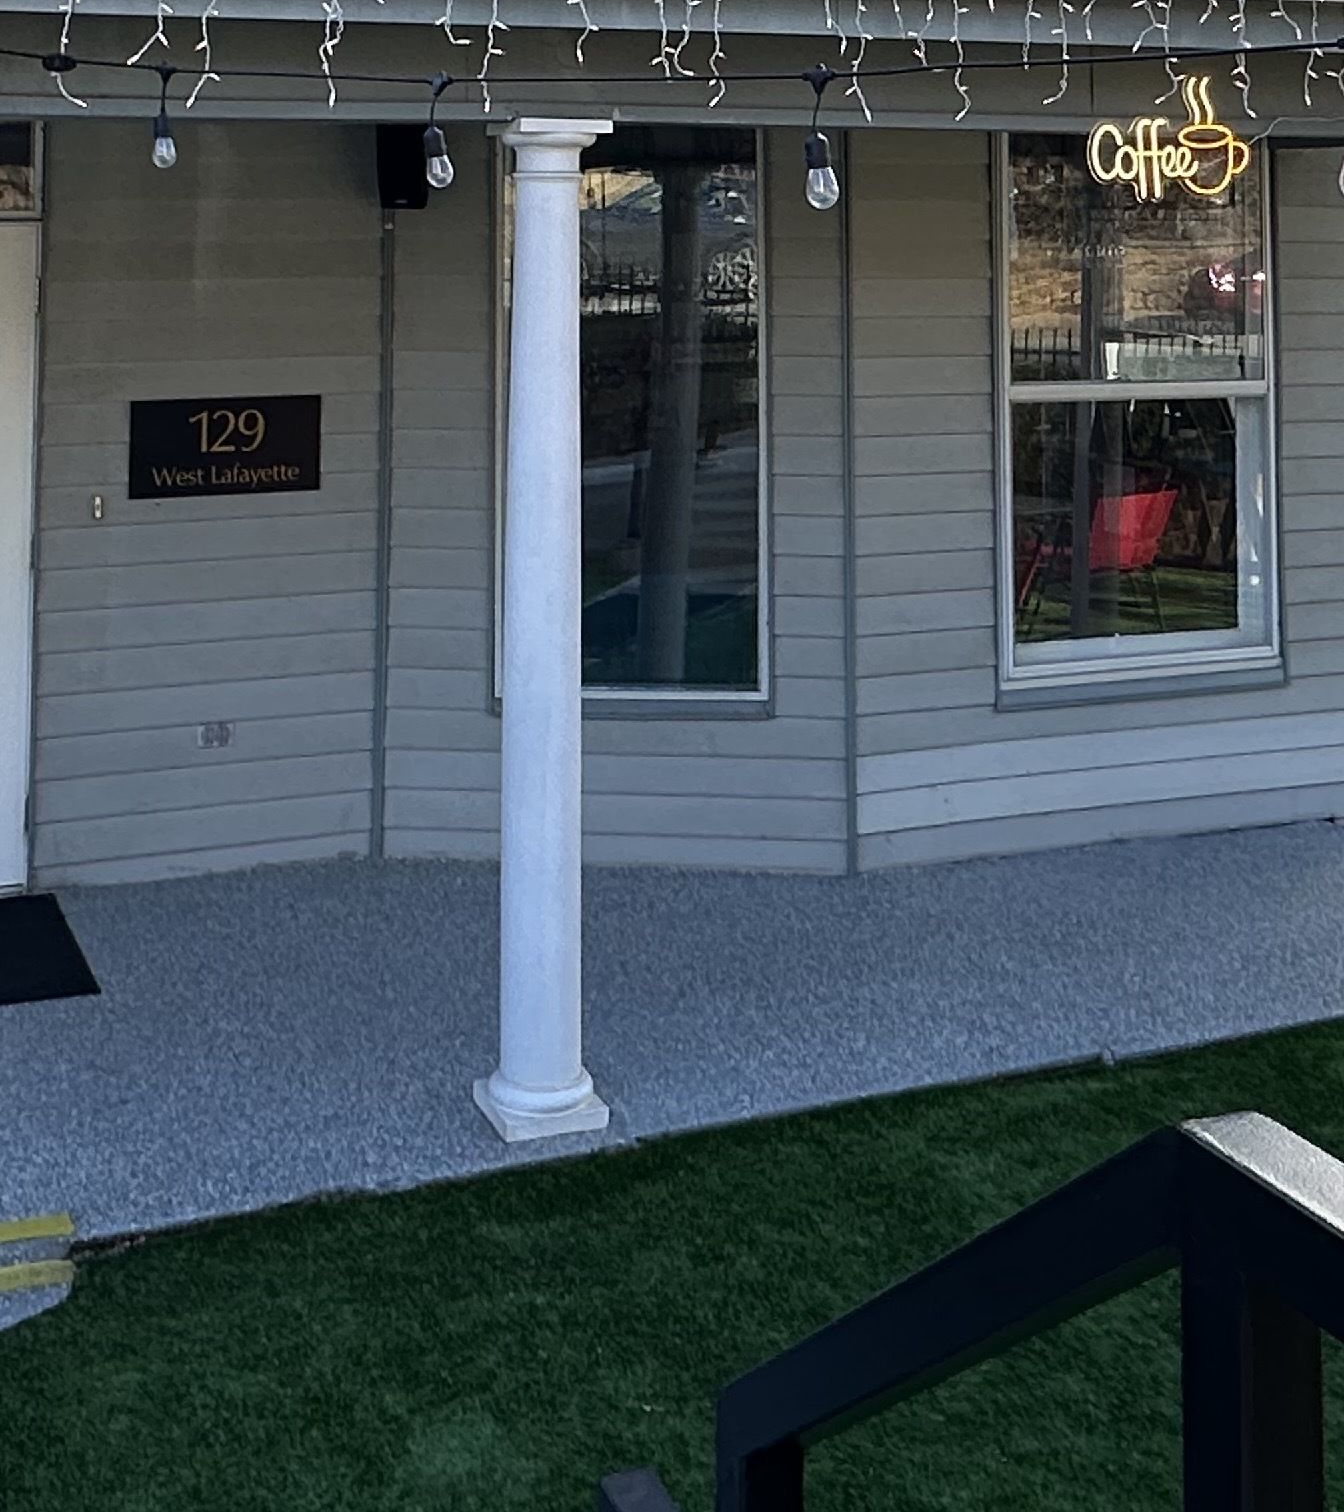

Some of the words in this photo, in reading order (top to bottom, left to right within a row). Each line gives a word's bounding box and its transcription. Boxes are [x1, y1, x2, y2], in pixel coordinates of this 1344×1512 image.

[1088, 117, 1199, 201] Coffee
[188, 408, 266, 453] 129
[152, 466, 204, 487] West
[211, 462, 301, 487] Lafayette
